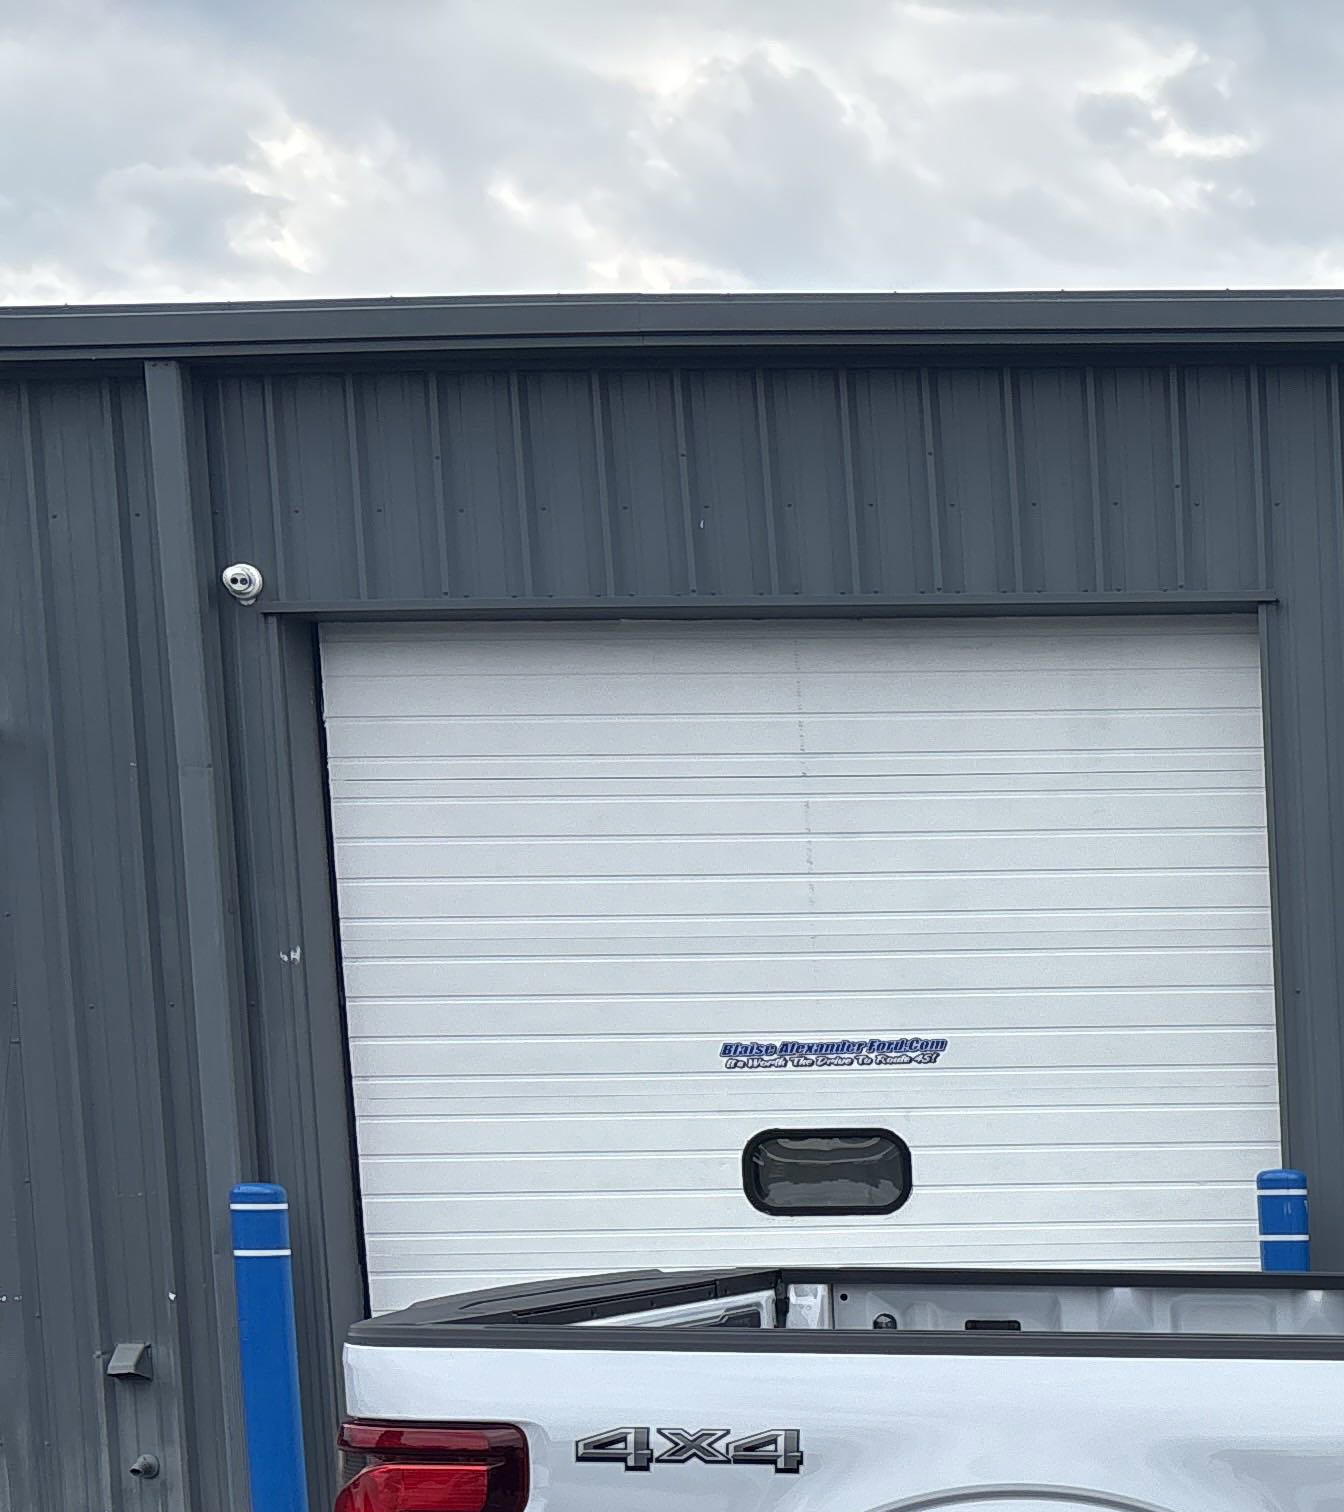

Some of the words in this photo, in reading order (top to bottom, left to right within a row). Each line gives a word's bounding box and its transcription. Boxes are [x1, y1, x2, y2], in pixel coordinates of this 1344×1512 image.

[720, 1041, 777, 1057] Blaise
[777, 1039, 865, 1057] Alexander
[746, 1056, 788, 1069] Worth
[789, 1055, 814, 1068] The
[816, 1054, 854, 1067] Drive
[855, 1054, 873, 1066] To
[875, 1053, 912, 1066] Route
